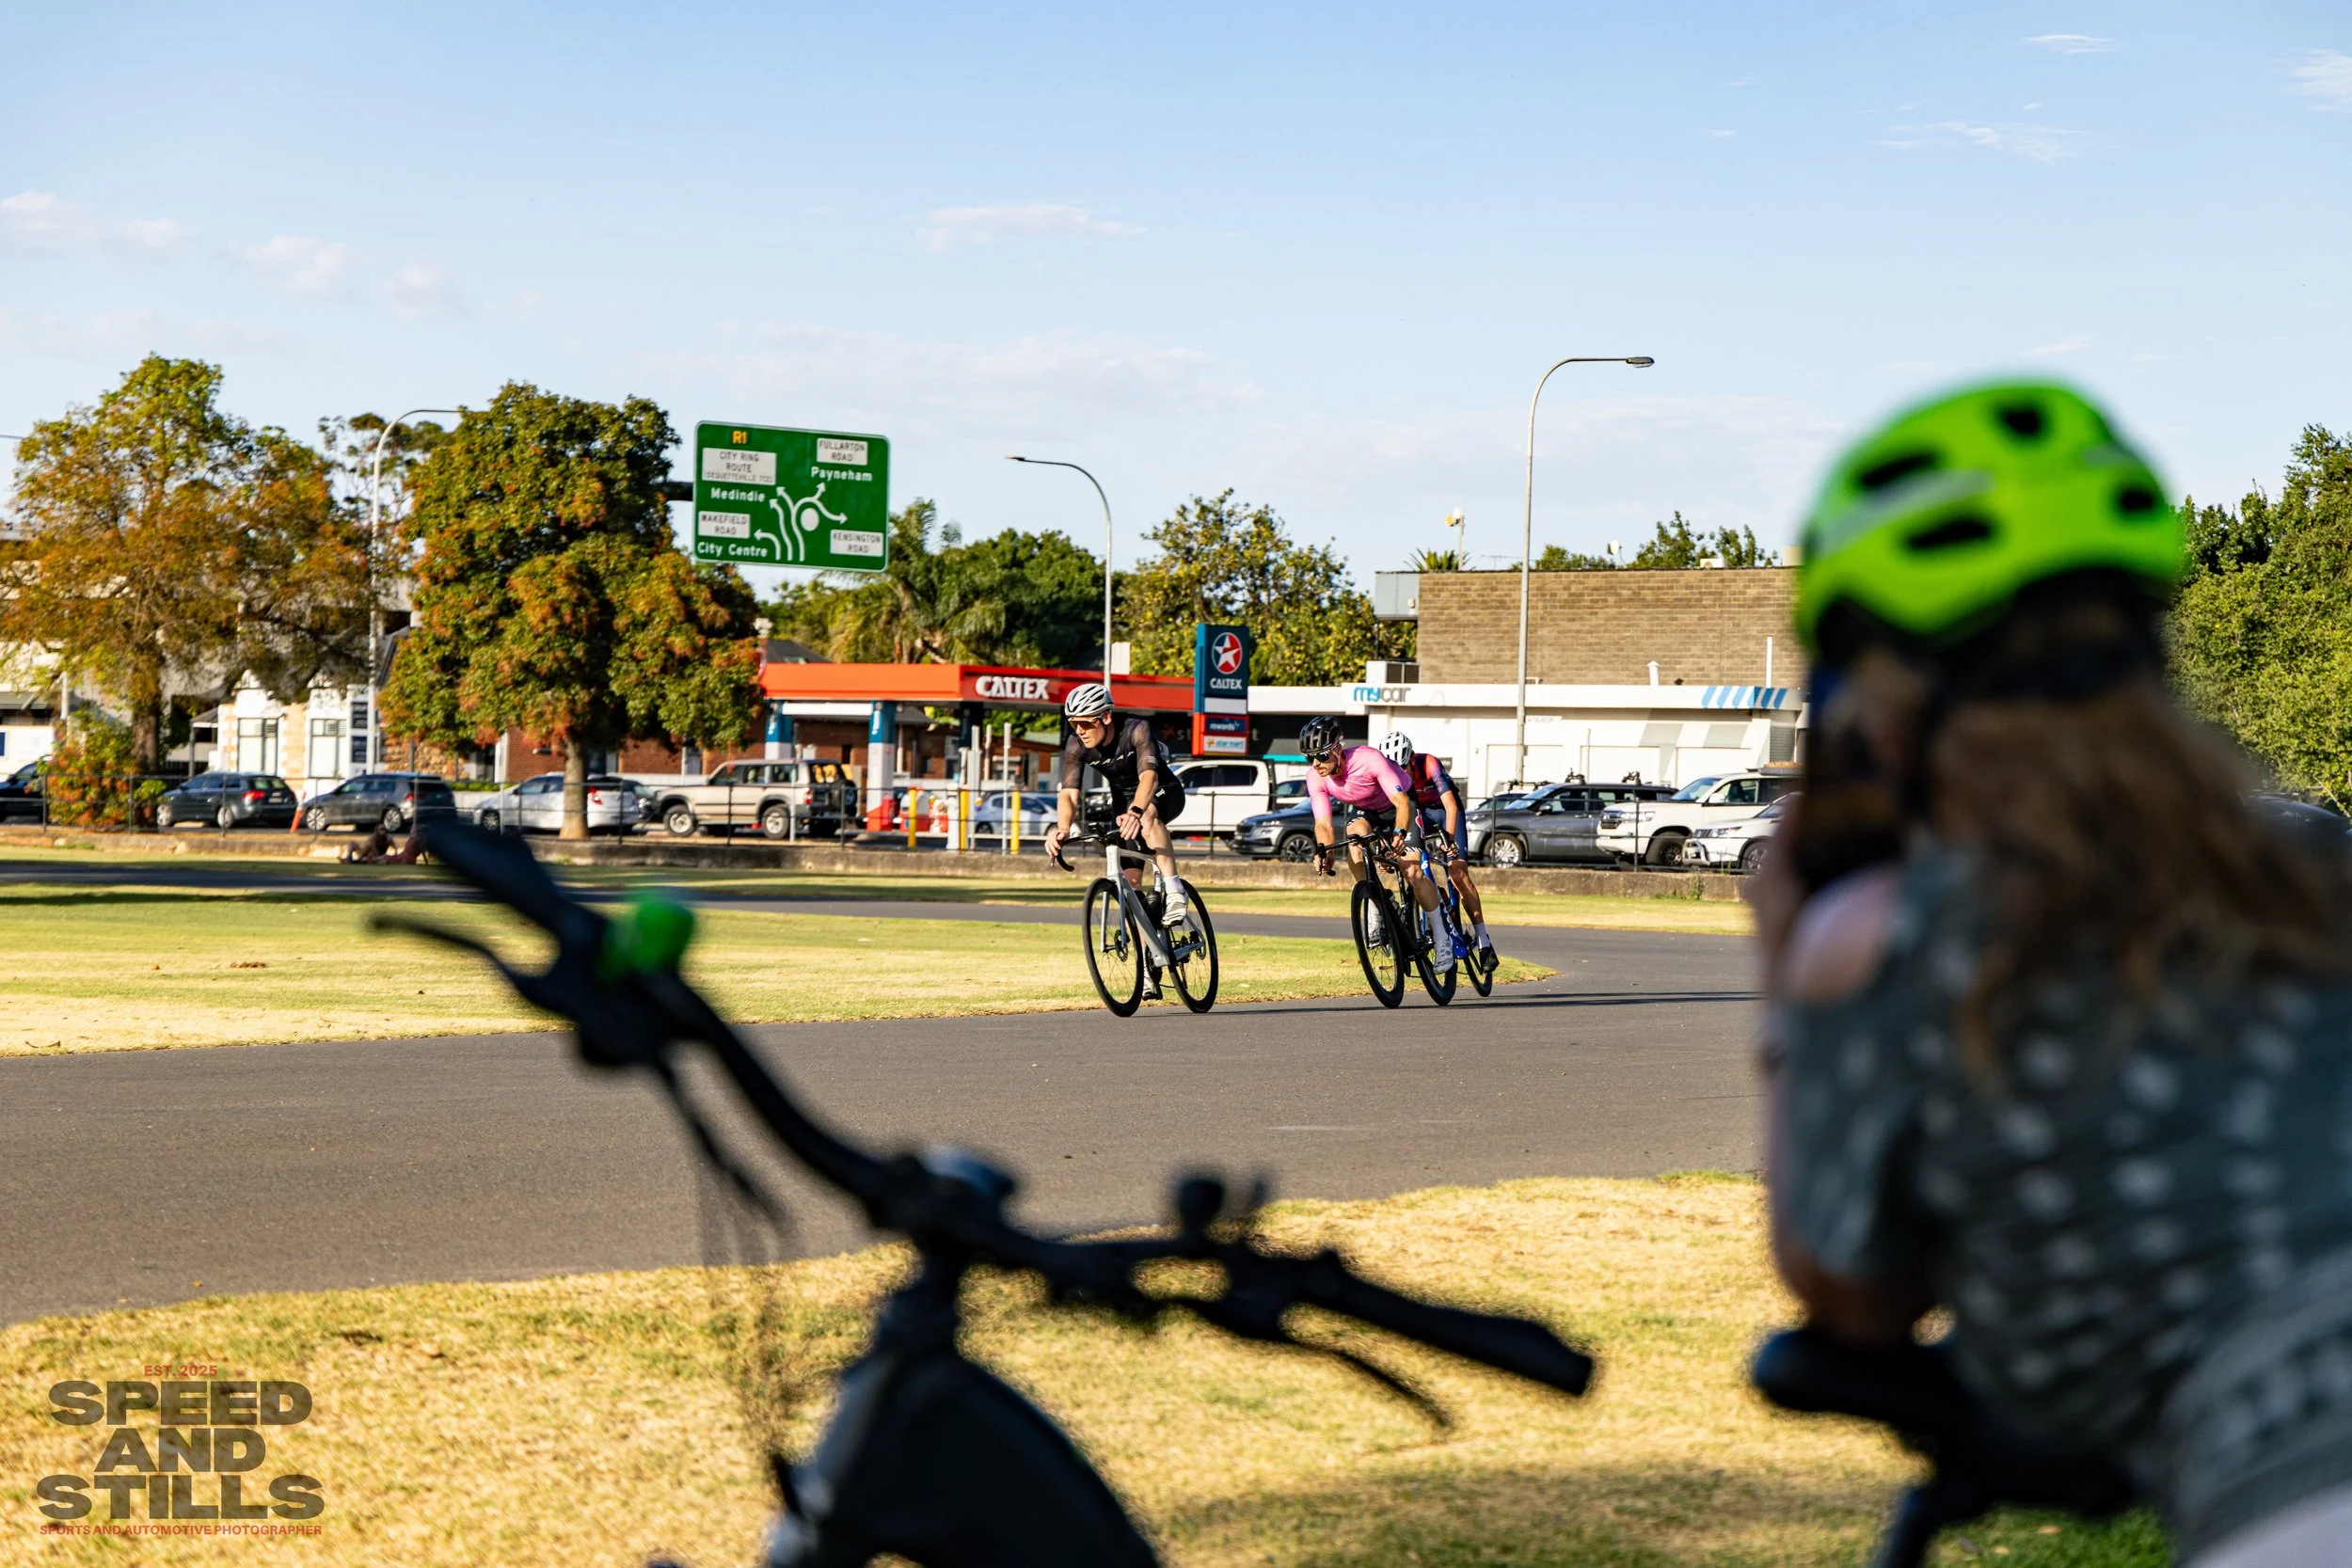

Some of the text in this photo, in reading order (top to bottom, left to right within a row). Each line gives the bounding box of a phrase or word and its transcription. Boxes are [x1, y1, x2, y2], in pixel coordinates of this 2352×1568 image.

[732, 430, 748, 444] R1
[819, 440, 865, 452] FULLARTON
[720, 451, 759, 462] CITY RING
[831, 452, 852, 462] ROAD
[726, 462, 752, 473] ROUTE
[811, 467, 873, 482] Payneham
[710, 487, 766, 502] Medindie
[702, 514, 746, 525] WAKEFIELD
[714, 526, 737, 535] ROAD
[834, 531, 881, 544] KENSINGTON
[698, 542, 768, 558] City Centre
[847, 544, 869, 553] ROAD
[975, 674, 1050, 701] CALTEX
[1210, 677, 1243, 690] CALTEX
